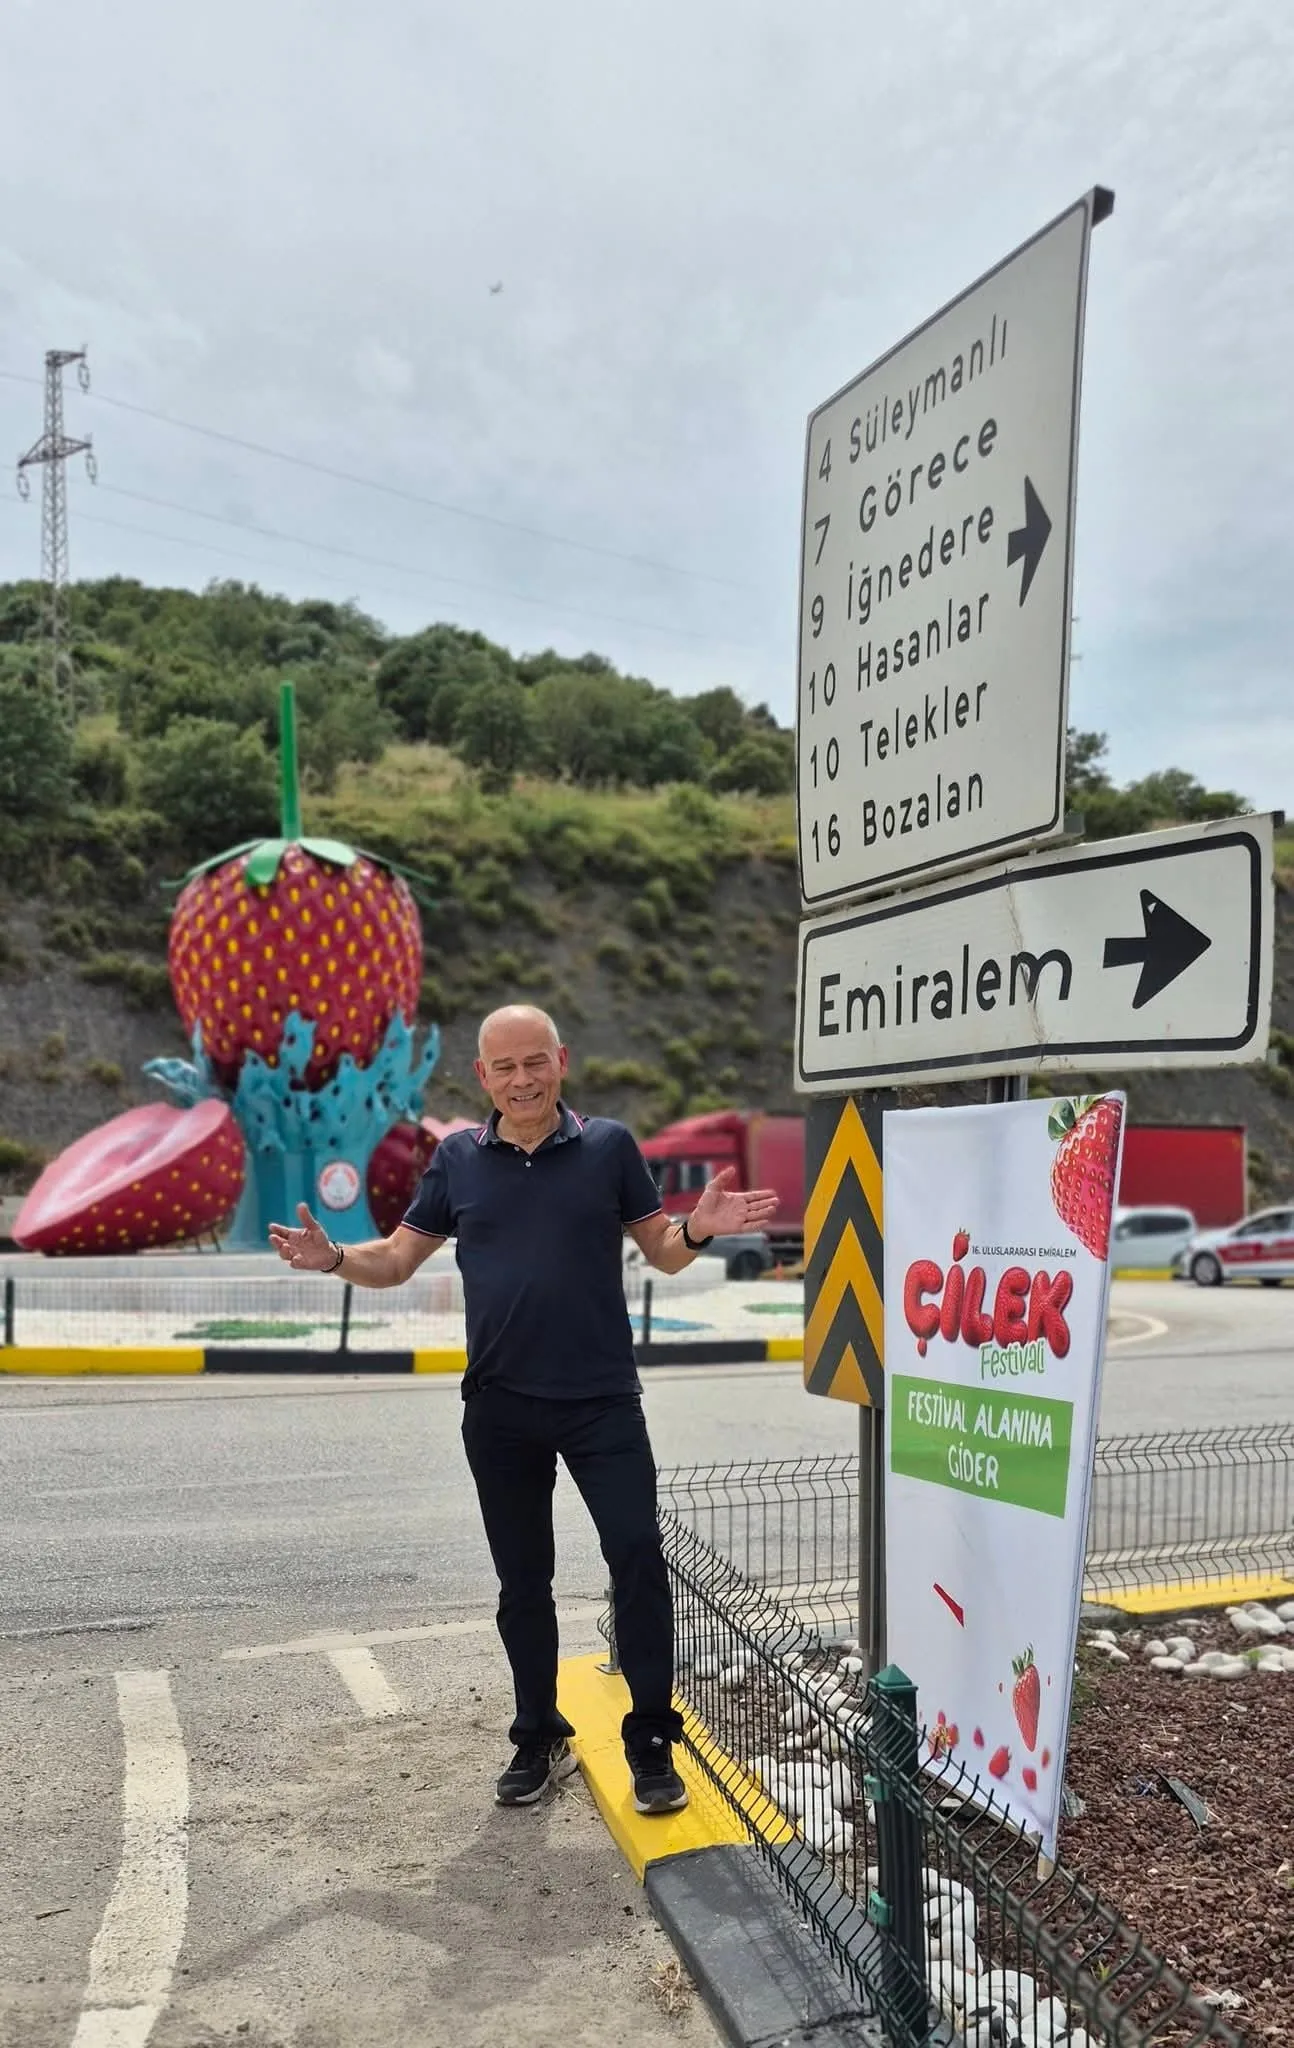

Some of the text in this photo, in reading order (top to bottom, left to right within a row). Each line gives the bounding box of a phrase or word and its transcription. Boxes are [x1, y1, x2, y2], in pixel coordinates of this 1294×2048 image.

[818, 313, 1008, 483] 4 Süleymanlı
[814, 417, 998, 566] 7 Görece
[811, 505, 994, 639] 9 İğnedere
[809, 592, 989, 715] 10 Hasanlar
[810, 681, 988, 788] 10 Telekler
[811, 772, 984, 863] 16 Bozalan
[818, 943, 1073, 1037] Emiralem
[903, 1229, 1073, 1360] ÇİLEK
[982, 1246, 1037, 1257] ULUSLARARASI
[1038, 1245, 1077, 1258] EMİRALEM
[981, 1340, 1046, 1380] Festivali
[908, 1387, 1053, 1450] FESTİVAL ALANINA
[948, 1441, 999, 1489] GİDER
